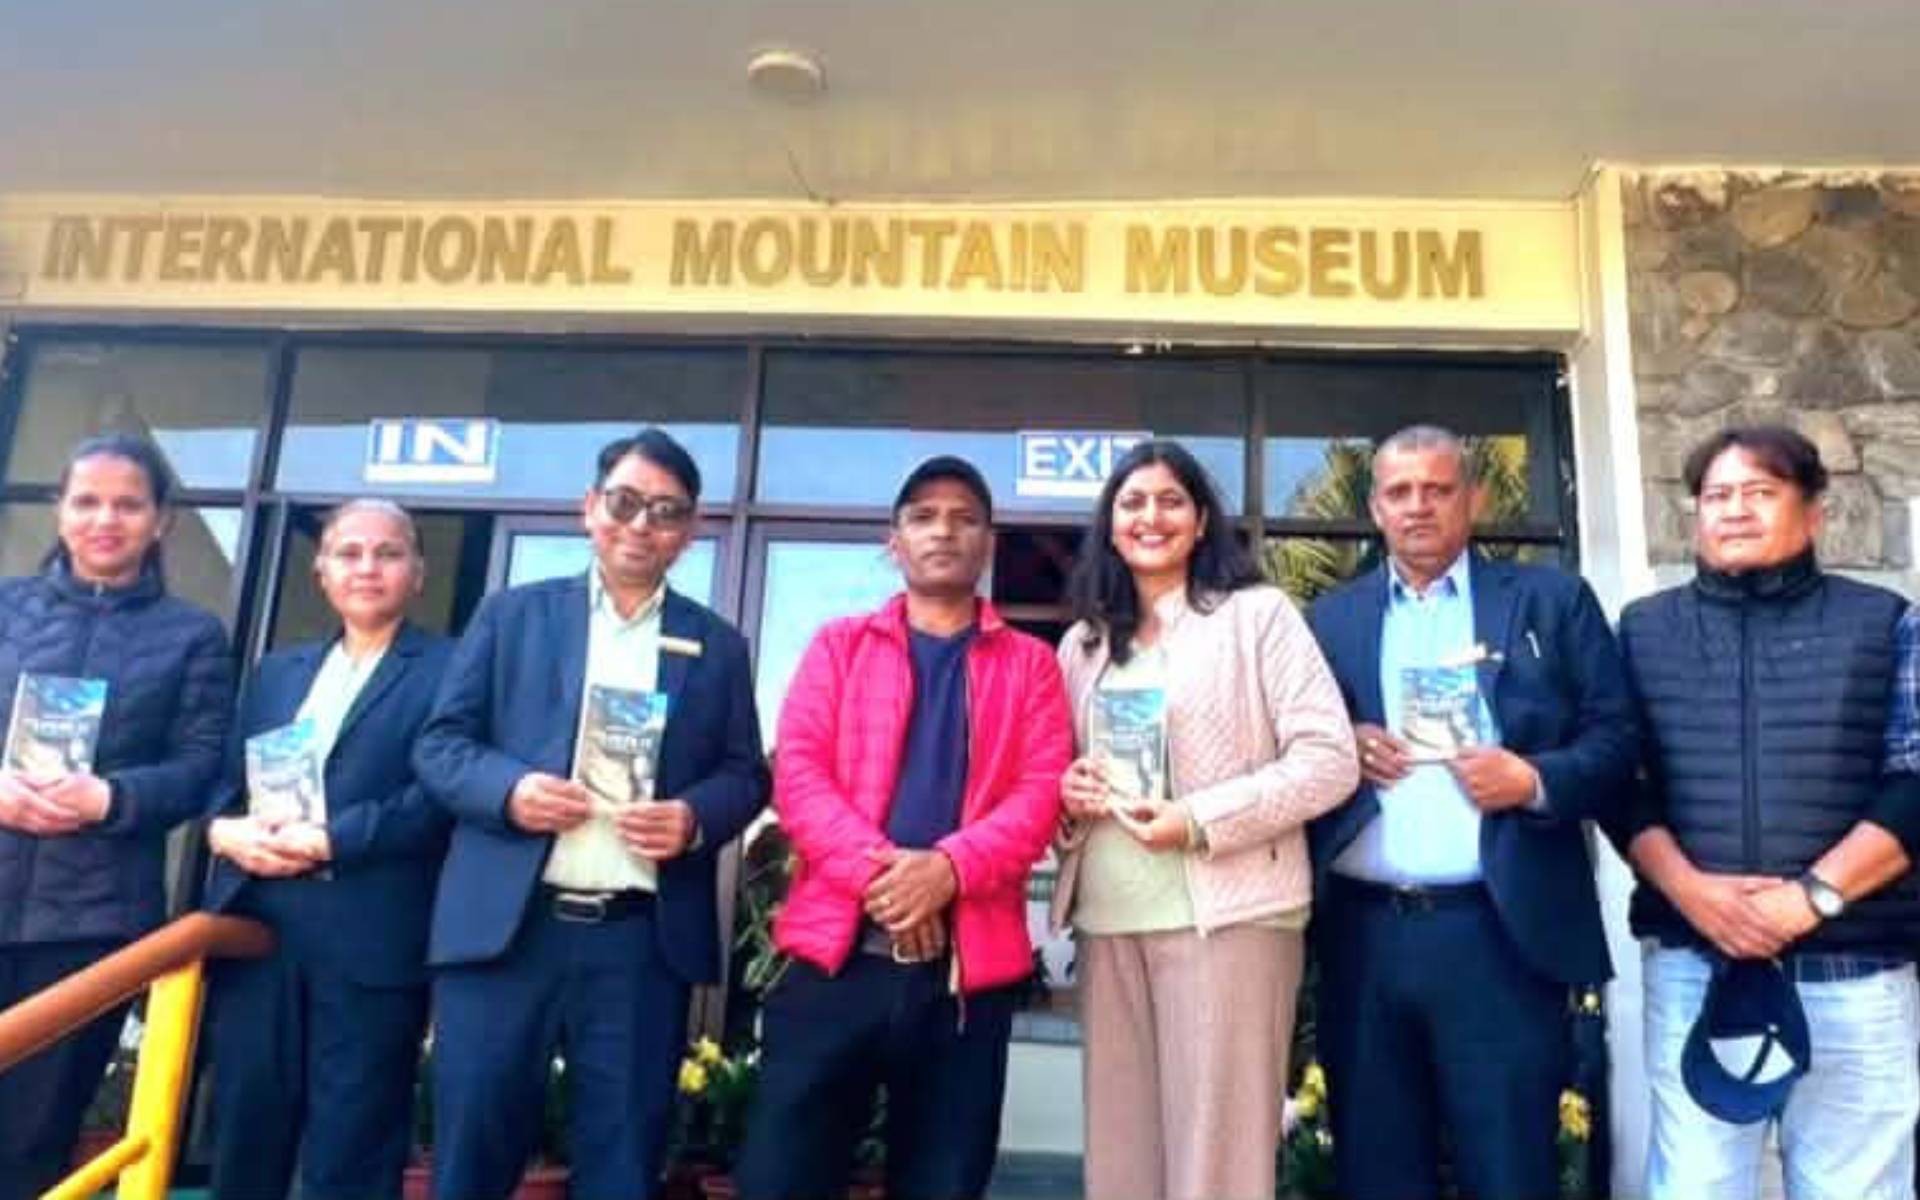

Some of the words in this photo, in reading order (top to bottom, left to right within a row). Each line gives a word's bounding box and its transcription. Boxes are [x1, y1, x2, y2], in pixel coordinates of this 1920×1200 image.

[42, 214, 632, 286] INTERNATIONAL
[668, 218, 1087, 294] MOUNTAIN
[1124, 224, 1486, 300] MUSEUM
[380, 420, 488, 463] IN
